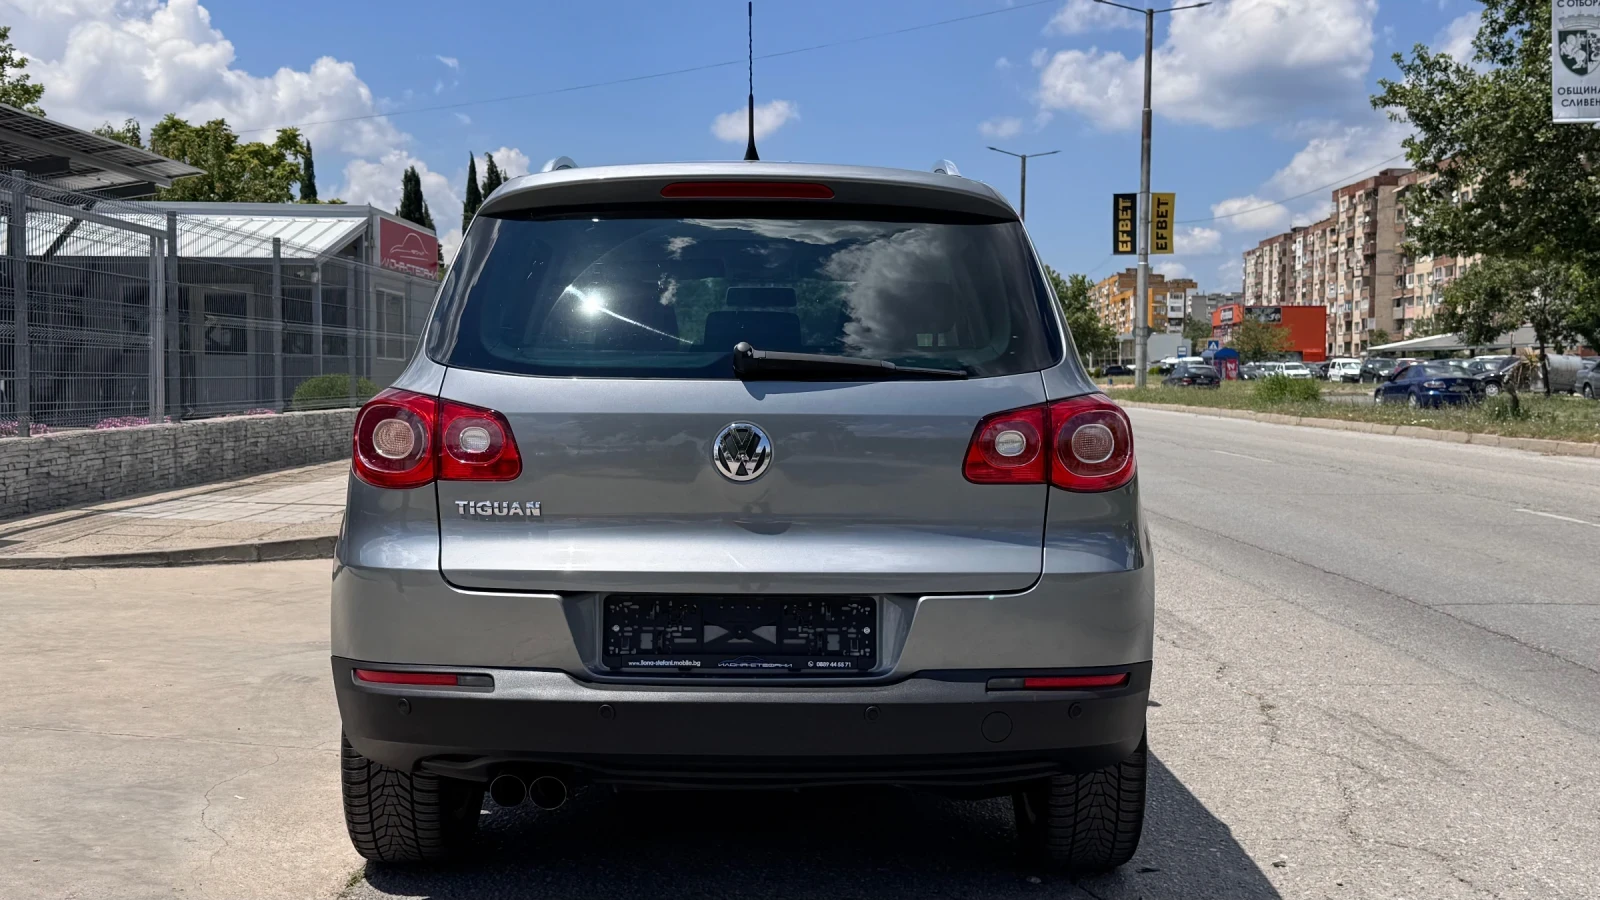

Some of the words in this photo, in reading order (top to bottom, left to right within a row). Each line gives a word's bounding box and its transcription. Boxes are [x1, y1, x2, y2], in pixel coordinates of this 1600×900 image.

[1118, 197, 1131, 252] EFBET
[1156, 197, 1169, 250] EFBET
[455, 500, 541, 516] TIGUAN
